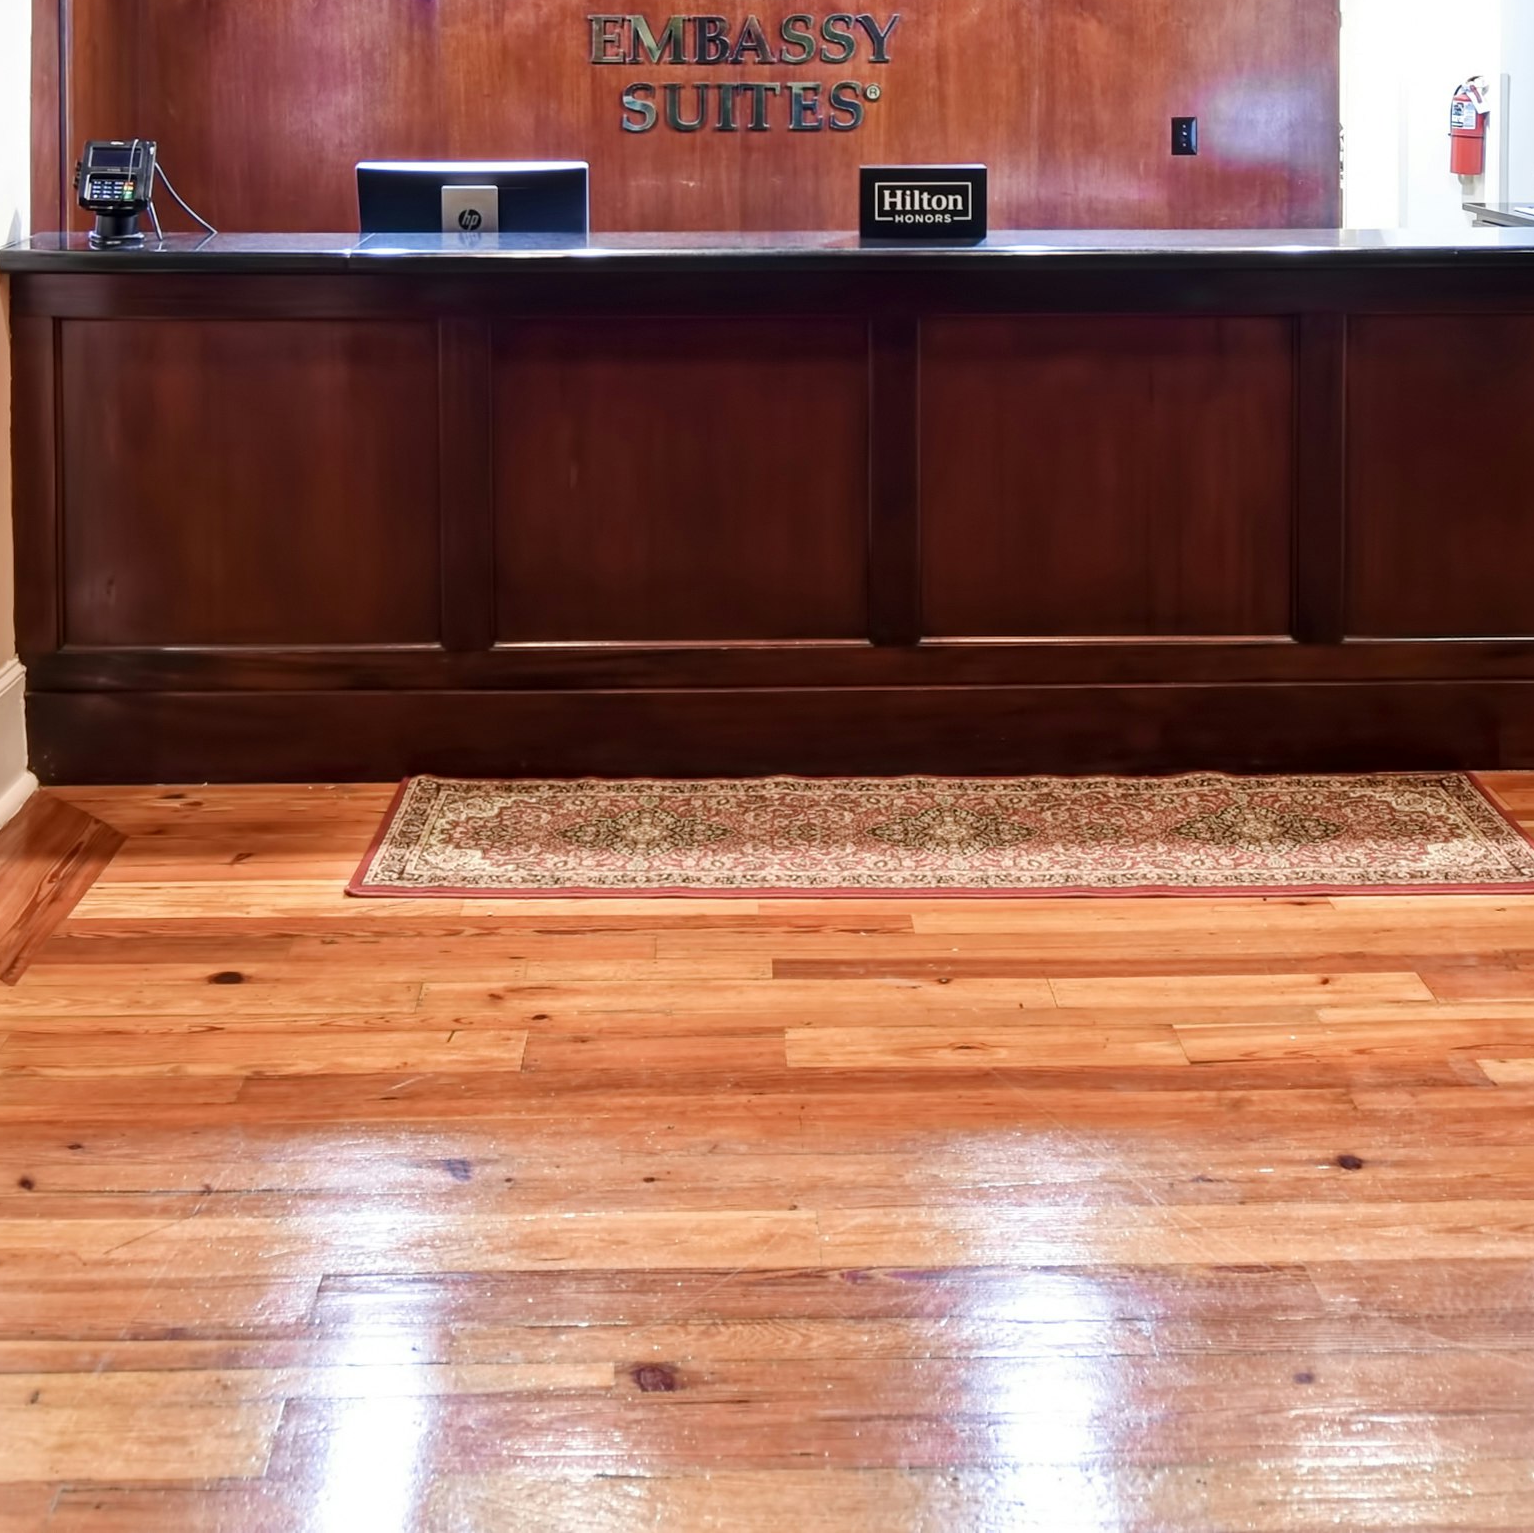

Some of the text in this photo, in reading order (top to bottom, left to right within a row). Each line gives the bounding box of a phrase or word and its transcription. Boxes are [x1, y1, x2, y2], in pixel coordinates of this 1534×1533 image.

[587, 13, 901, 65] EMBASSY
[883, 189, 964, 211] Hilton
[461, 209, 480, 231] hp
[894, 214, 952, 224] HONORS
